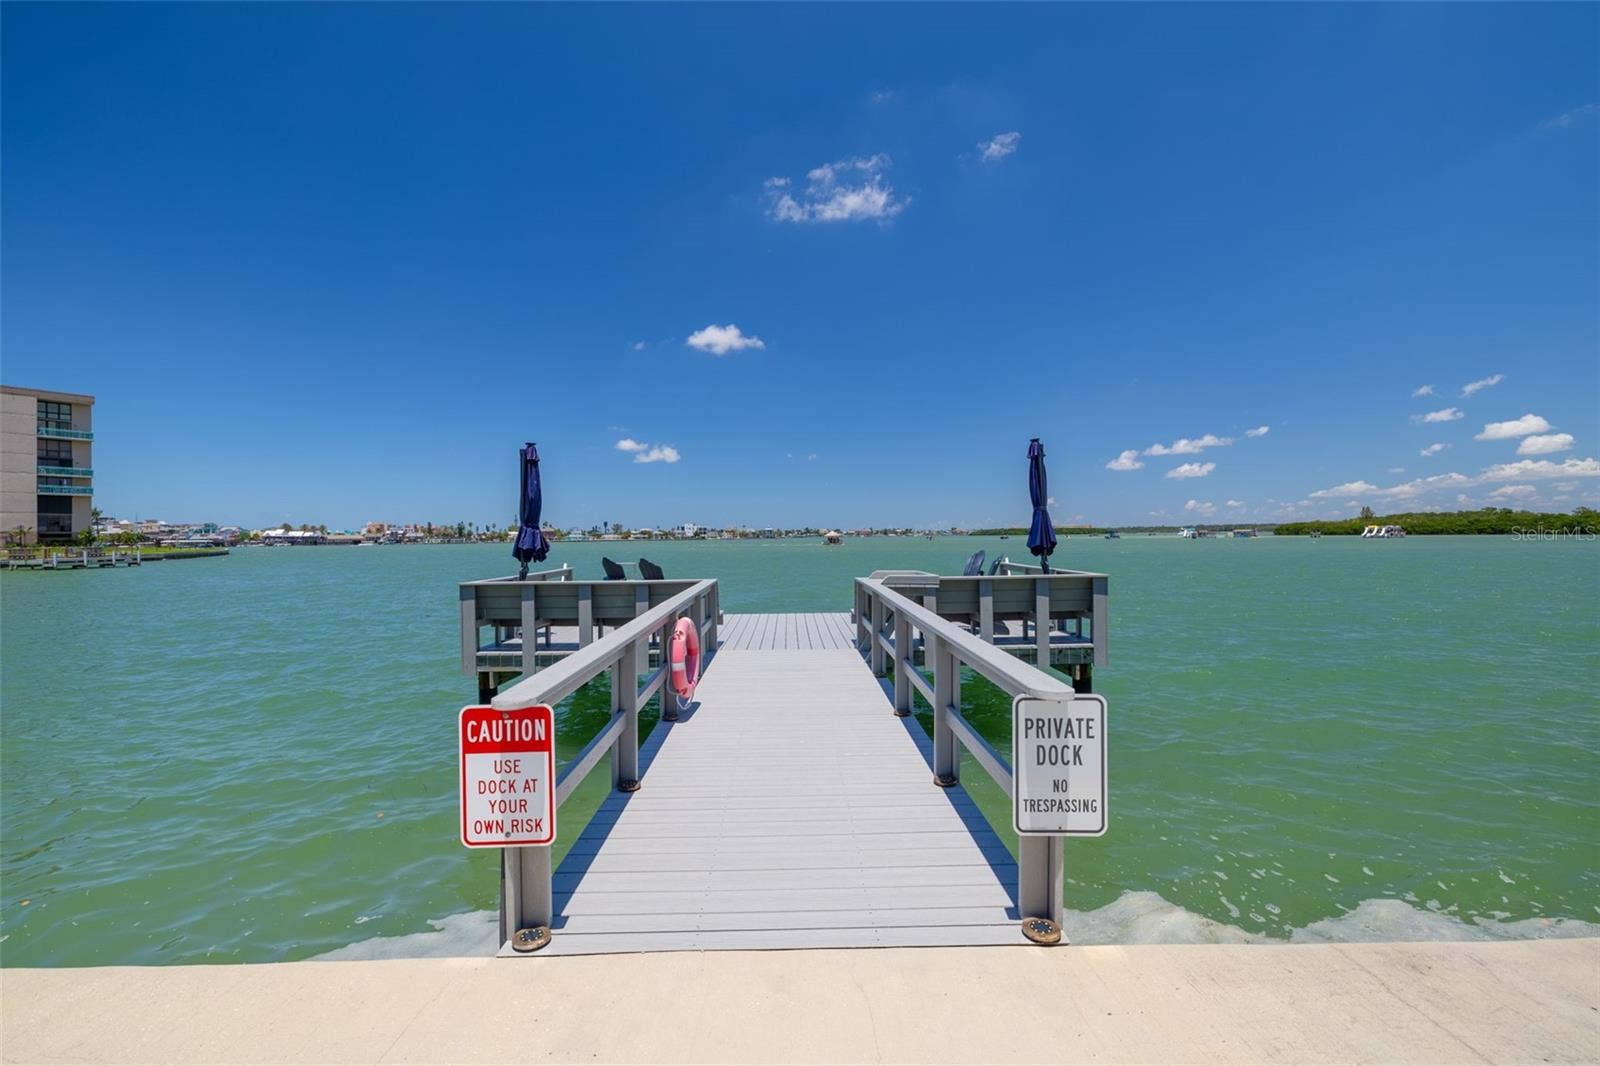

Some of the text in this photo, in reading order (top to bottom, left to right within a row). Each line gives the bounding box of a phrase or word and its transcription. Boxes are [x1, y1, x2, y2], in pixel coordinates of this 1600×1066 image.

[466, 719, 546, 743] CAUTION
[1024, 718, 1095, 739] PRIVATE
[1036, 745, 1083, 766] DOCK
[494, 760, 521, 774] USE
[478, 779, 538, 795] DOCK AT
[1053, 779, 1068, 793] NO
[489, 799, 528, 814] YOUR
[1023, 799, 1097, 813] TRESPASSING
[474, 818, 543, 834] OWN RISK
